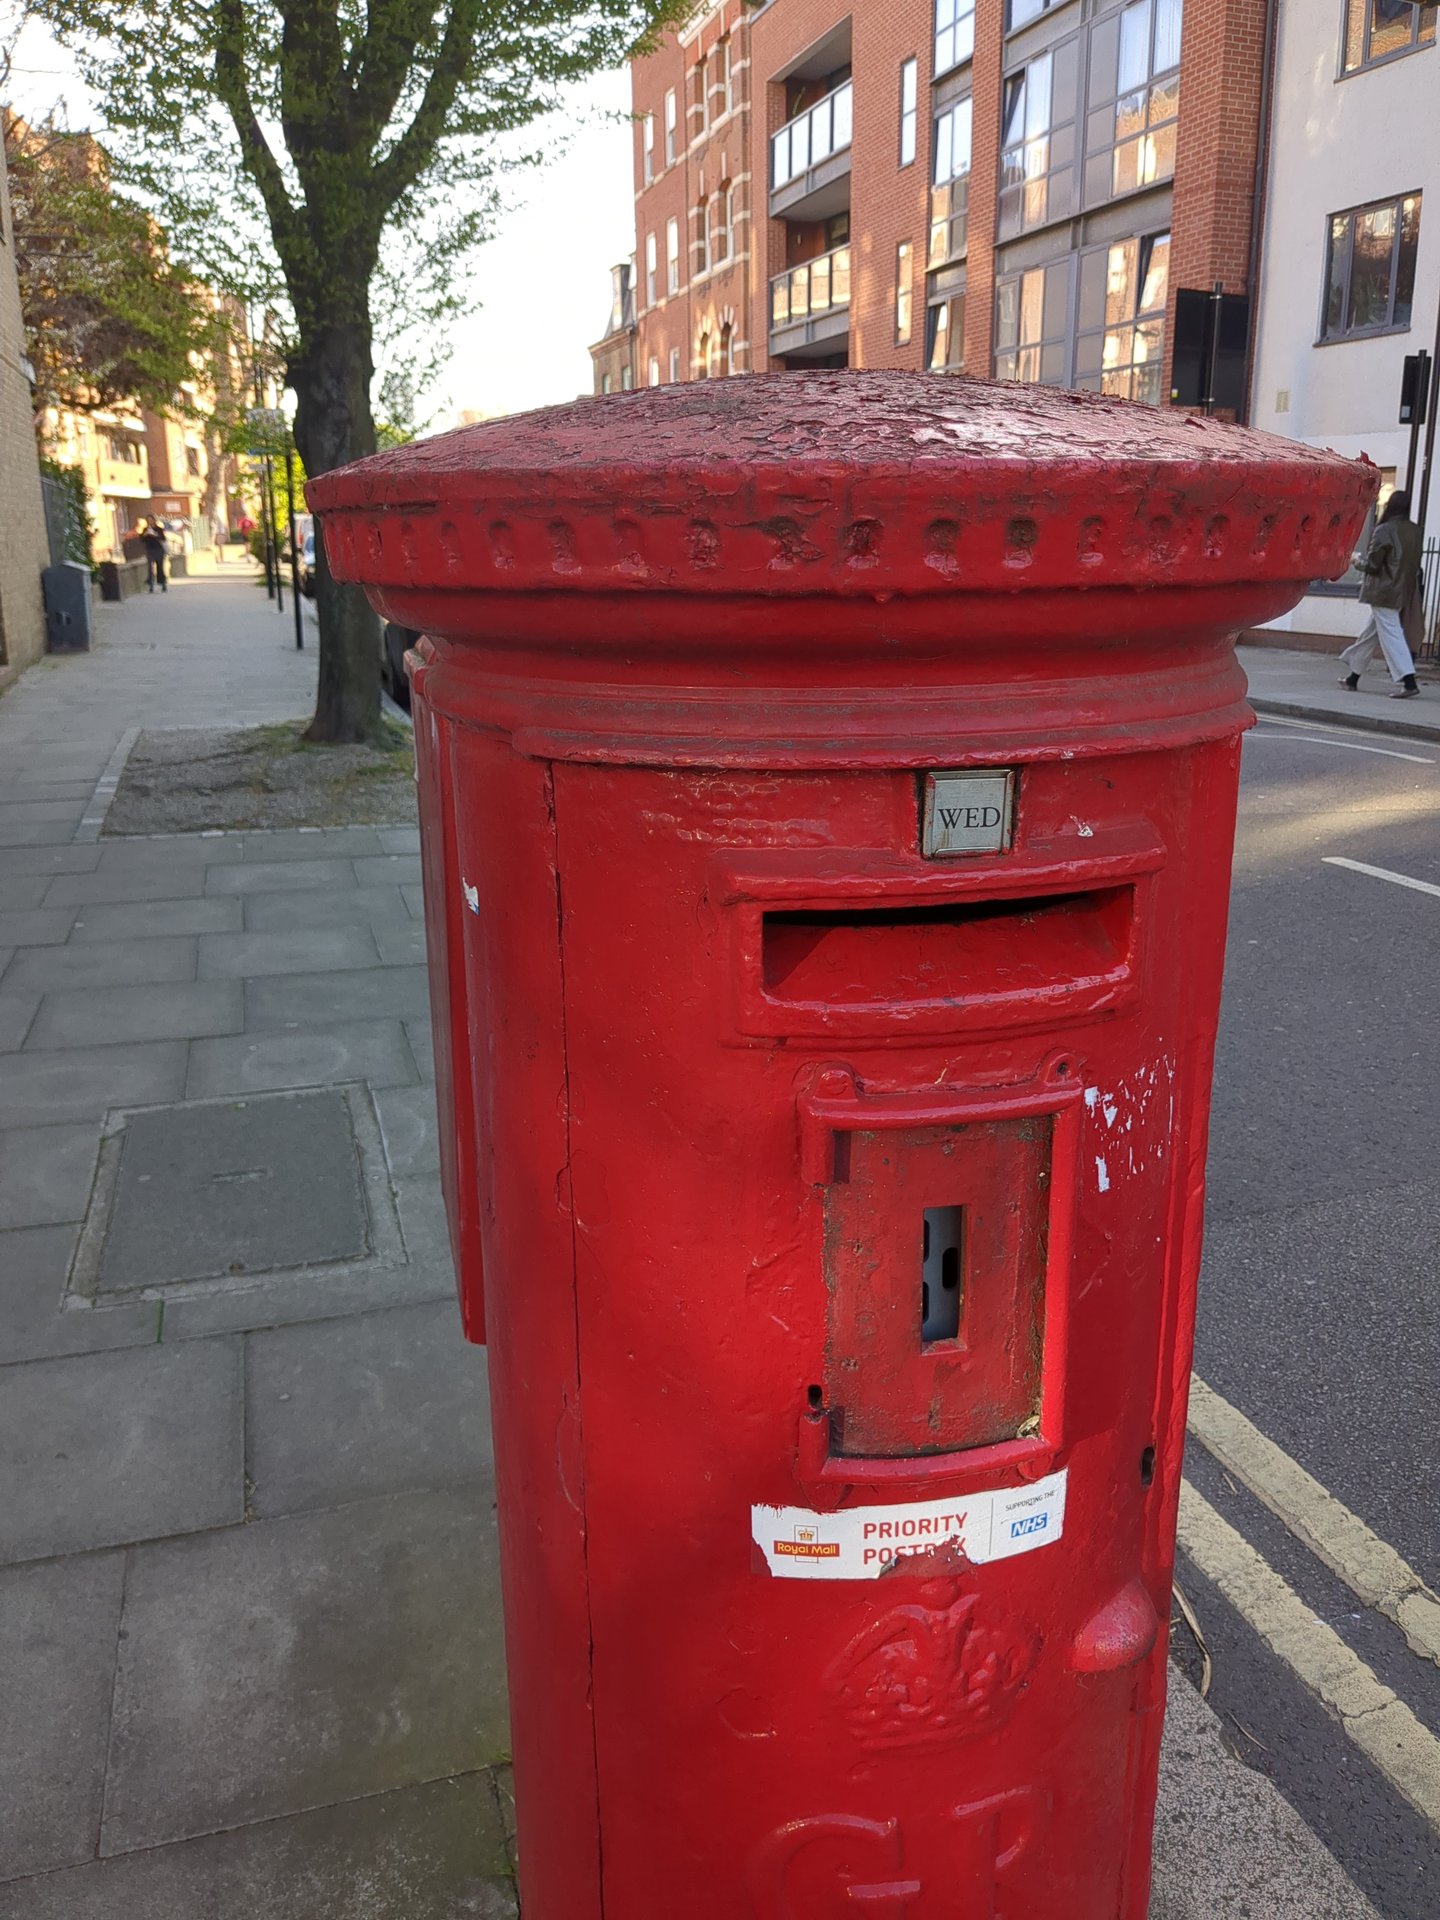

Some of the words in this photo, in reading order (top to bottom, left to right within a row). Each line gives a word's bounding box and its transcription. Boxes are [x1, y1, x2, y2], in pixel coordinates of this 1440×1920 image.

[938, 807, 1000, 829] WED
[1005, 1495, 1043, 1512] SUPPORTING
[1044, 1490, 1055, 1499] THE
[864, 1512, 968, 1539] PRIORITY
[1012, 1514, 1046, 1536] NHS
[777, 1542, 808, 1555] Royal
[811, 1545, 836, 1555] Mail
[864, 1537, 966, 1565] POSTX
